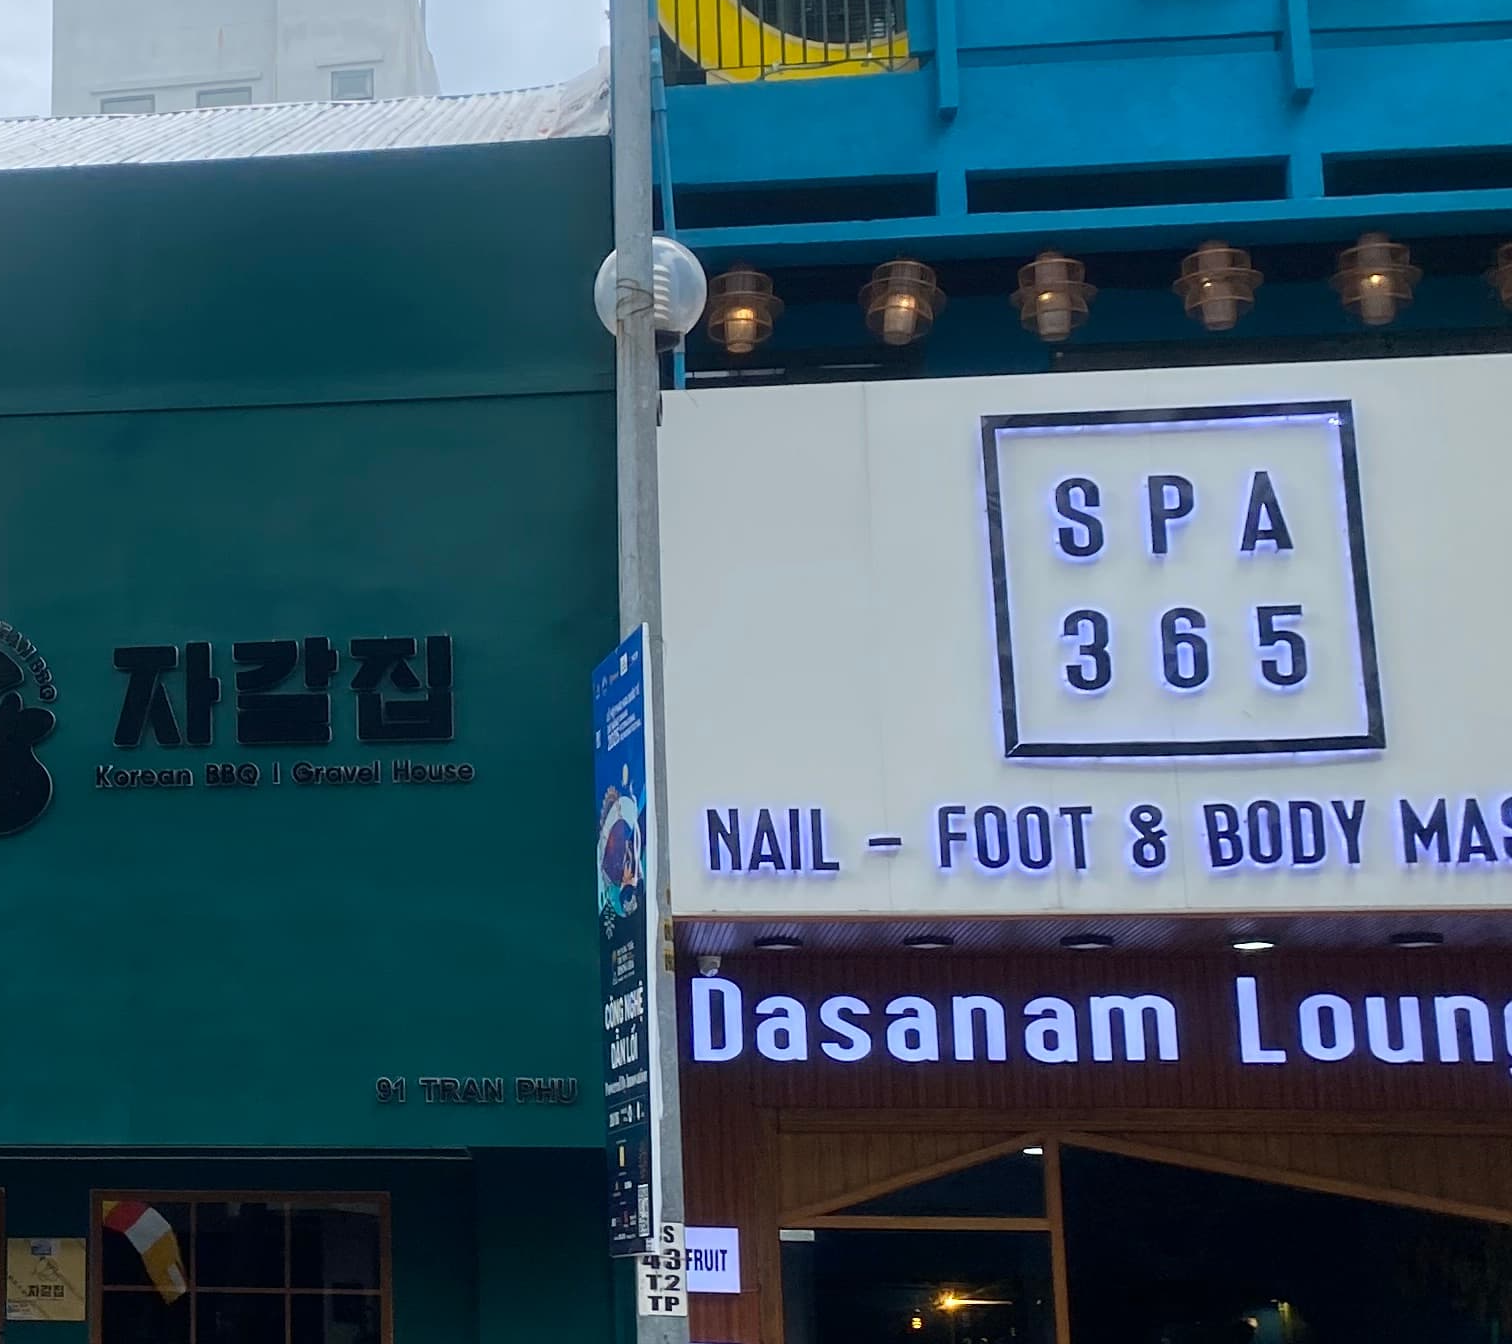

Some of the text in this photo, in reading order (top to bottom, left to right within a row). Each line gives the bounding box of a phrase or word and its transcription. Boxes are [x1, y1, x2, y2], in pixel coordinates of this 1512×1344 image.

[1055, 471, 1294, 557] SPA
[1063, 605, 1307, 691] 365
[28, 655, 57, 702] BBQ
[113, 635, 454, 747] 자갈집
[96, 764, 194, 788] Korean
[205, 762, 261, 787] BBQ
[292, 760, 382, 785] Gravel
[392, 759, 476, 784] House
[707, 807, 841, 872] NAIL
[937, 804, 1093, 870] FOOT
[1129, 803, 1169, 868] &
[1203, 799, 1366, 868] BODY
[691, 975, 1512, 1076] Dasanam Loun
[376, 1076, 578, 1104] 91 TRAN PHU
[641, 1248, 681, 1271] 43
[685, 1248, 728, 1272] FRUIT
[645, 1273, 680, 1292] T2
[647, 1295, 680, 1312] TP
